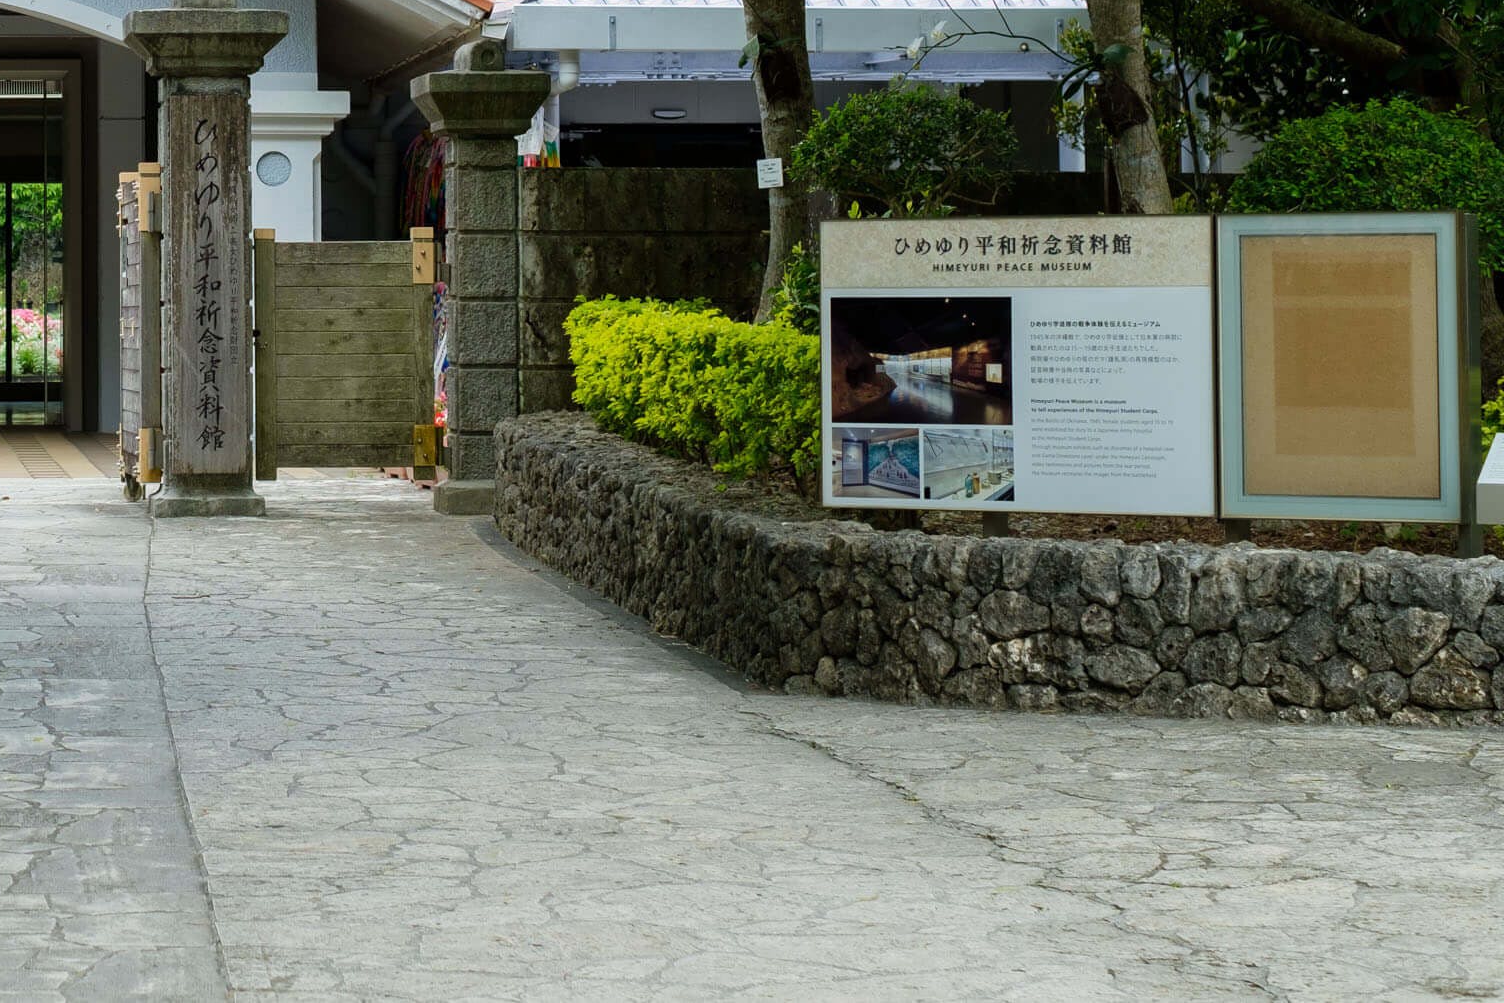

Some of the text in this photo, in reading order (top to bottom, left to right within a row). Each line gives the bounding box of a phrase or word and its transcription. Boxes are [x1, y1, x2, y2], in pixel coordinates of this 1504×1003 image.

[894, 233, 1133, 256] ひめゆり平和祈念資料館
[933, 262, 1092, 272] HIMEYURI PEACE MUSEUM
[193, 118, 224, 451] ひめゆり平和祈念資料館
